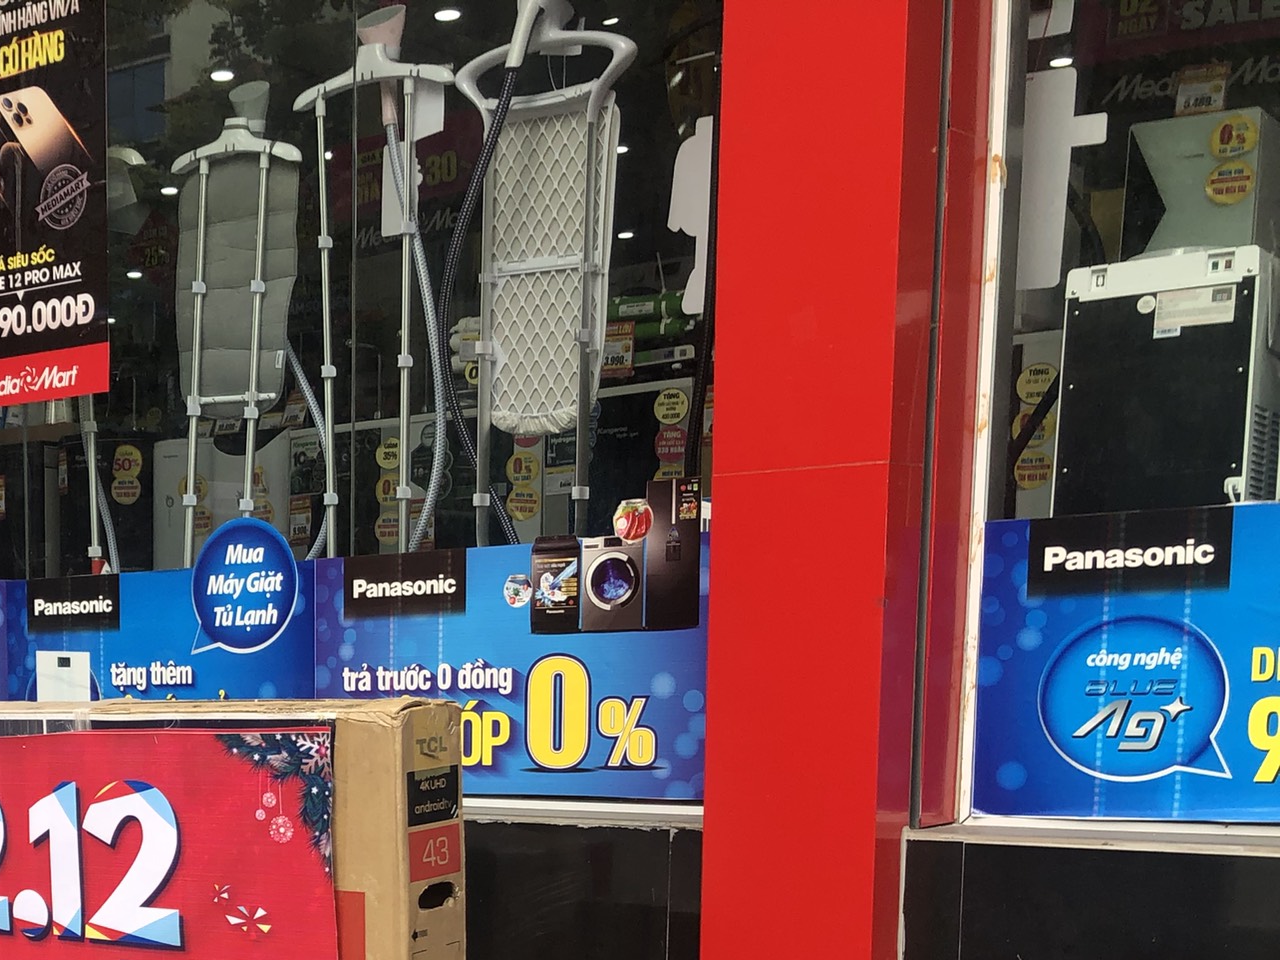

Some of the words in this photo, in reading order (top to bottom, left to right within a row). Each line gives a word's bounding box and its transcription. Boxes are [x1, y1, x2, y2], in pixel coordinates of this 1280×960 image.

[18, 2, 48, 31] HÃNG
[0, 36, 19, 76] CÓ
[20, 29, 65, 71] HÀNG
[40, 178, 84, 215] MEDIAMART
[8, 251, 29, 269] SIÊU
[30, 244, 56, 264] SỐC
[8, 274, 23, 288] 12
[24, 268, 50, 286] PRO
[52, 261, 82, 281] MAX
[225, 544, 264, 565] Mua
[1044, 538, 1215, 572] Panasonic
[207, 572, 244, 599] Máy
[246, 571, 283, 598] Giặt
[352, 574, 457, 599] Panasonic
[34, 595, 113, 616] Panasonic
[214, 604, 234, 627] Tủ
[235, 604, 278, 631] Lạnh
[1086, 650, 1132, 670] công
[1133, 647, 1183, 670] nghệ
[110, 662, 147, 691] tặng
[150, 661, 193, 686] thêm
[342, 663, 371, 692] trả
[376, 663, 431, 692] trước
[437, 664, 451, 690] 0
[457, 657, 514, 695] đồng
[1085, 679, 1178, 696] BLUE
[416, 736, 448, 755] TCL
[460, 700, 511, 767] ÓP
[422, 836, 450, 867] 43
